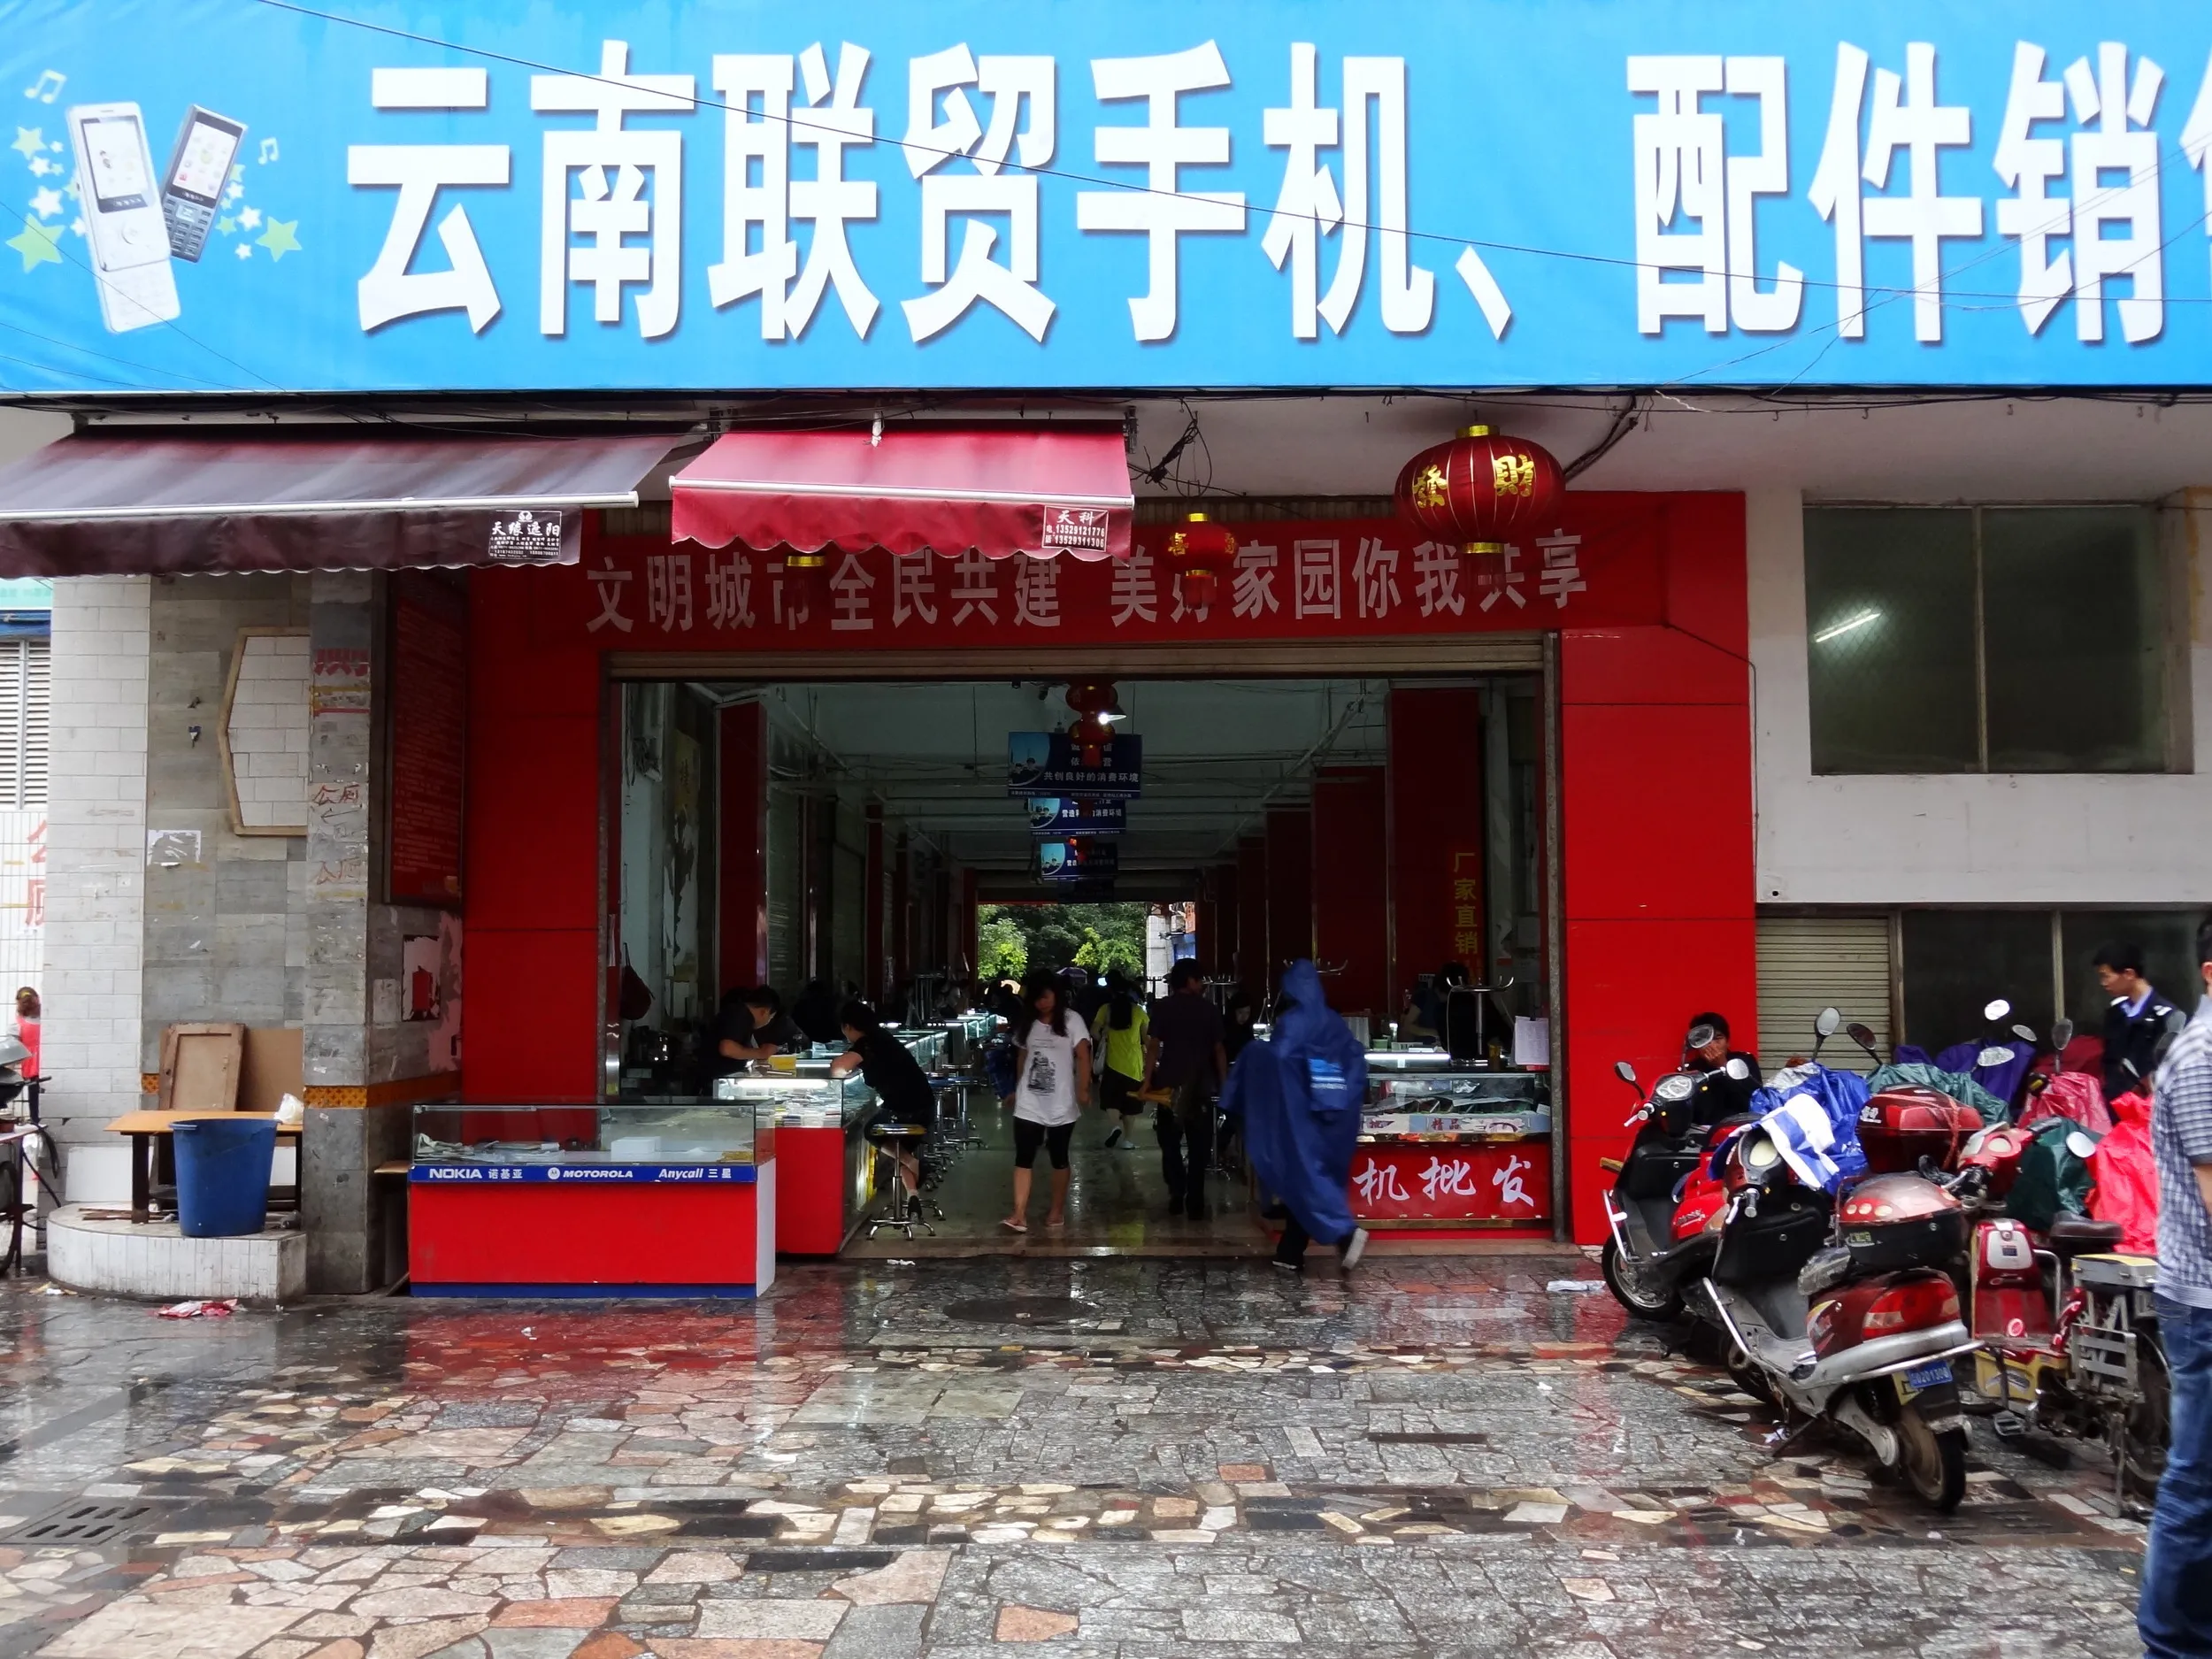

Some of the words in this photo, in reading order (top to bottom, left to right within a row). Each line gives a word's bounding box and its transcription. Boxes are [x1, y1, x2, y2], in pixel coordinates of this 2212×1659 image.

[1056, 510, 1094, 526] 天科
[1044, 772, 1139, 782] 共创良好的消费环境
[1062, 809, 1122, 818] 营造消费环境
[1454, 852, 1479, 955] 厂家直销
[429, 1169, 482, 1179] NOKIA
[488, 1169, 523, 1179] 诺基亚
[563, 1170, 634, 1179] MOTOROLA
[658, 1168, 703, 1180] Anycall
[708, 1169, 732, 1179] 三星
